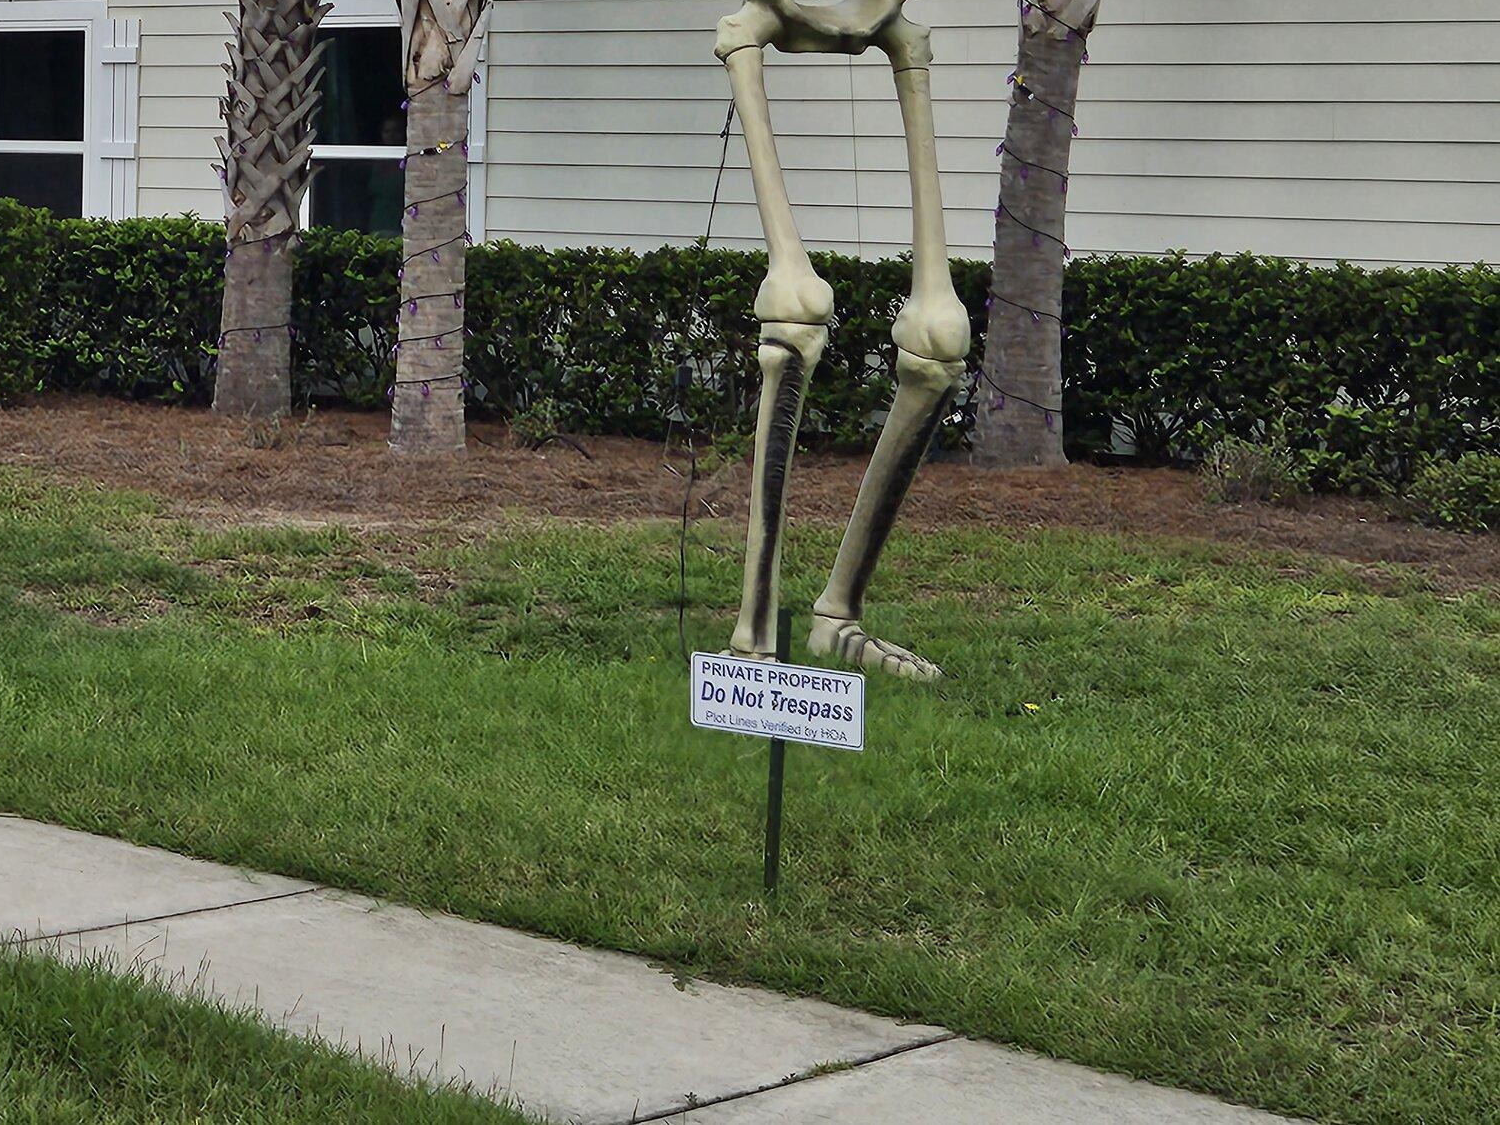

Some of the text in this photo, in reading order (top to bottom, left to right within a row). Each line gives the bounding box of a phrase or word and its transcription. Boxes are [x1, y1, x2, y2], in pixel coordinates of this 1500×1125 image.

[702, 661, 852, 695] PRIVATE PROPERTY
[701, 680, 854, 722] Do Not Trespass
[705, 710, 848, 741] Plot Lines Verified by HOA
